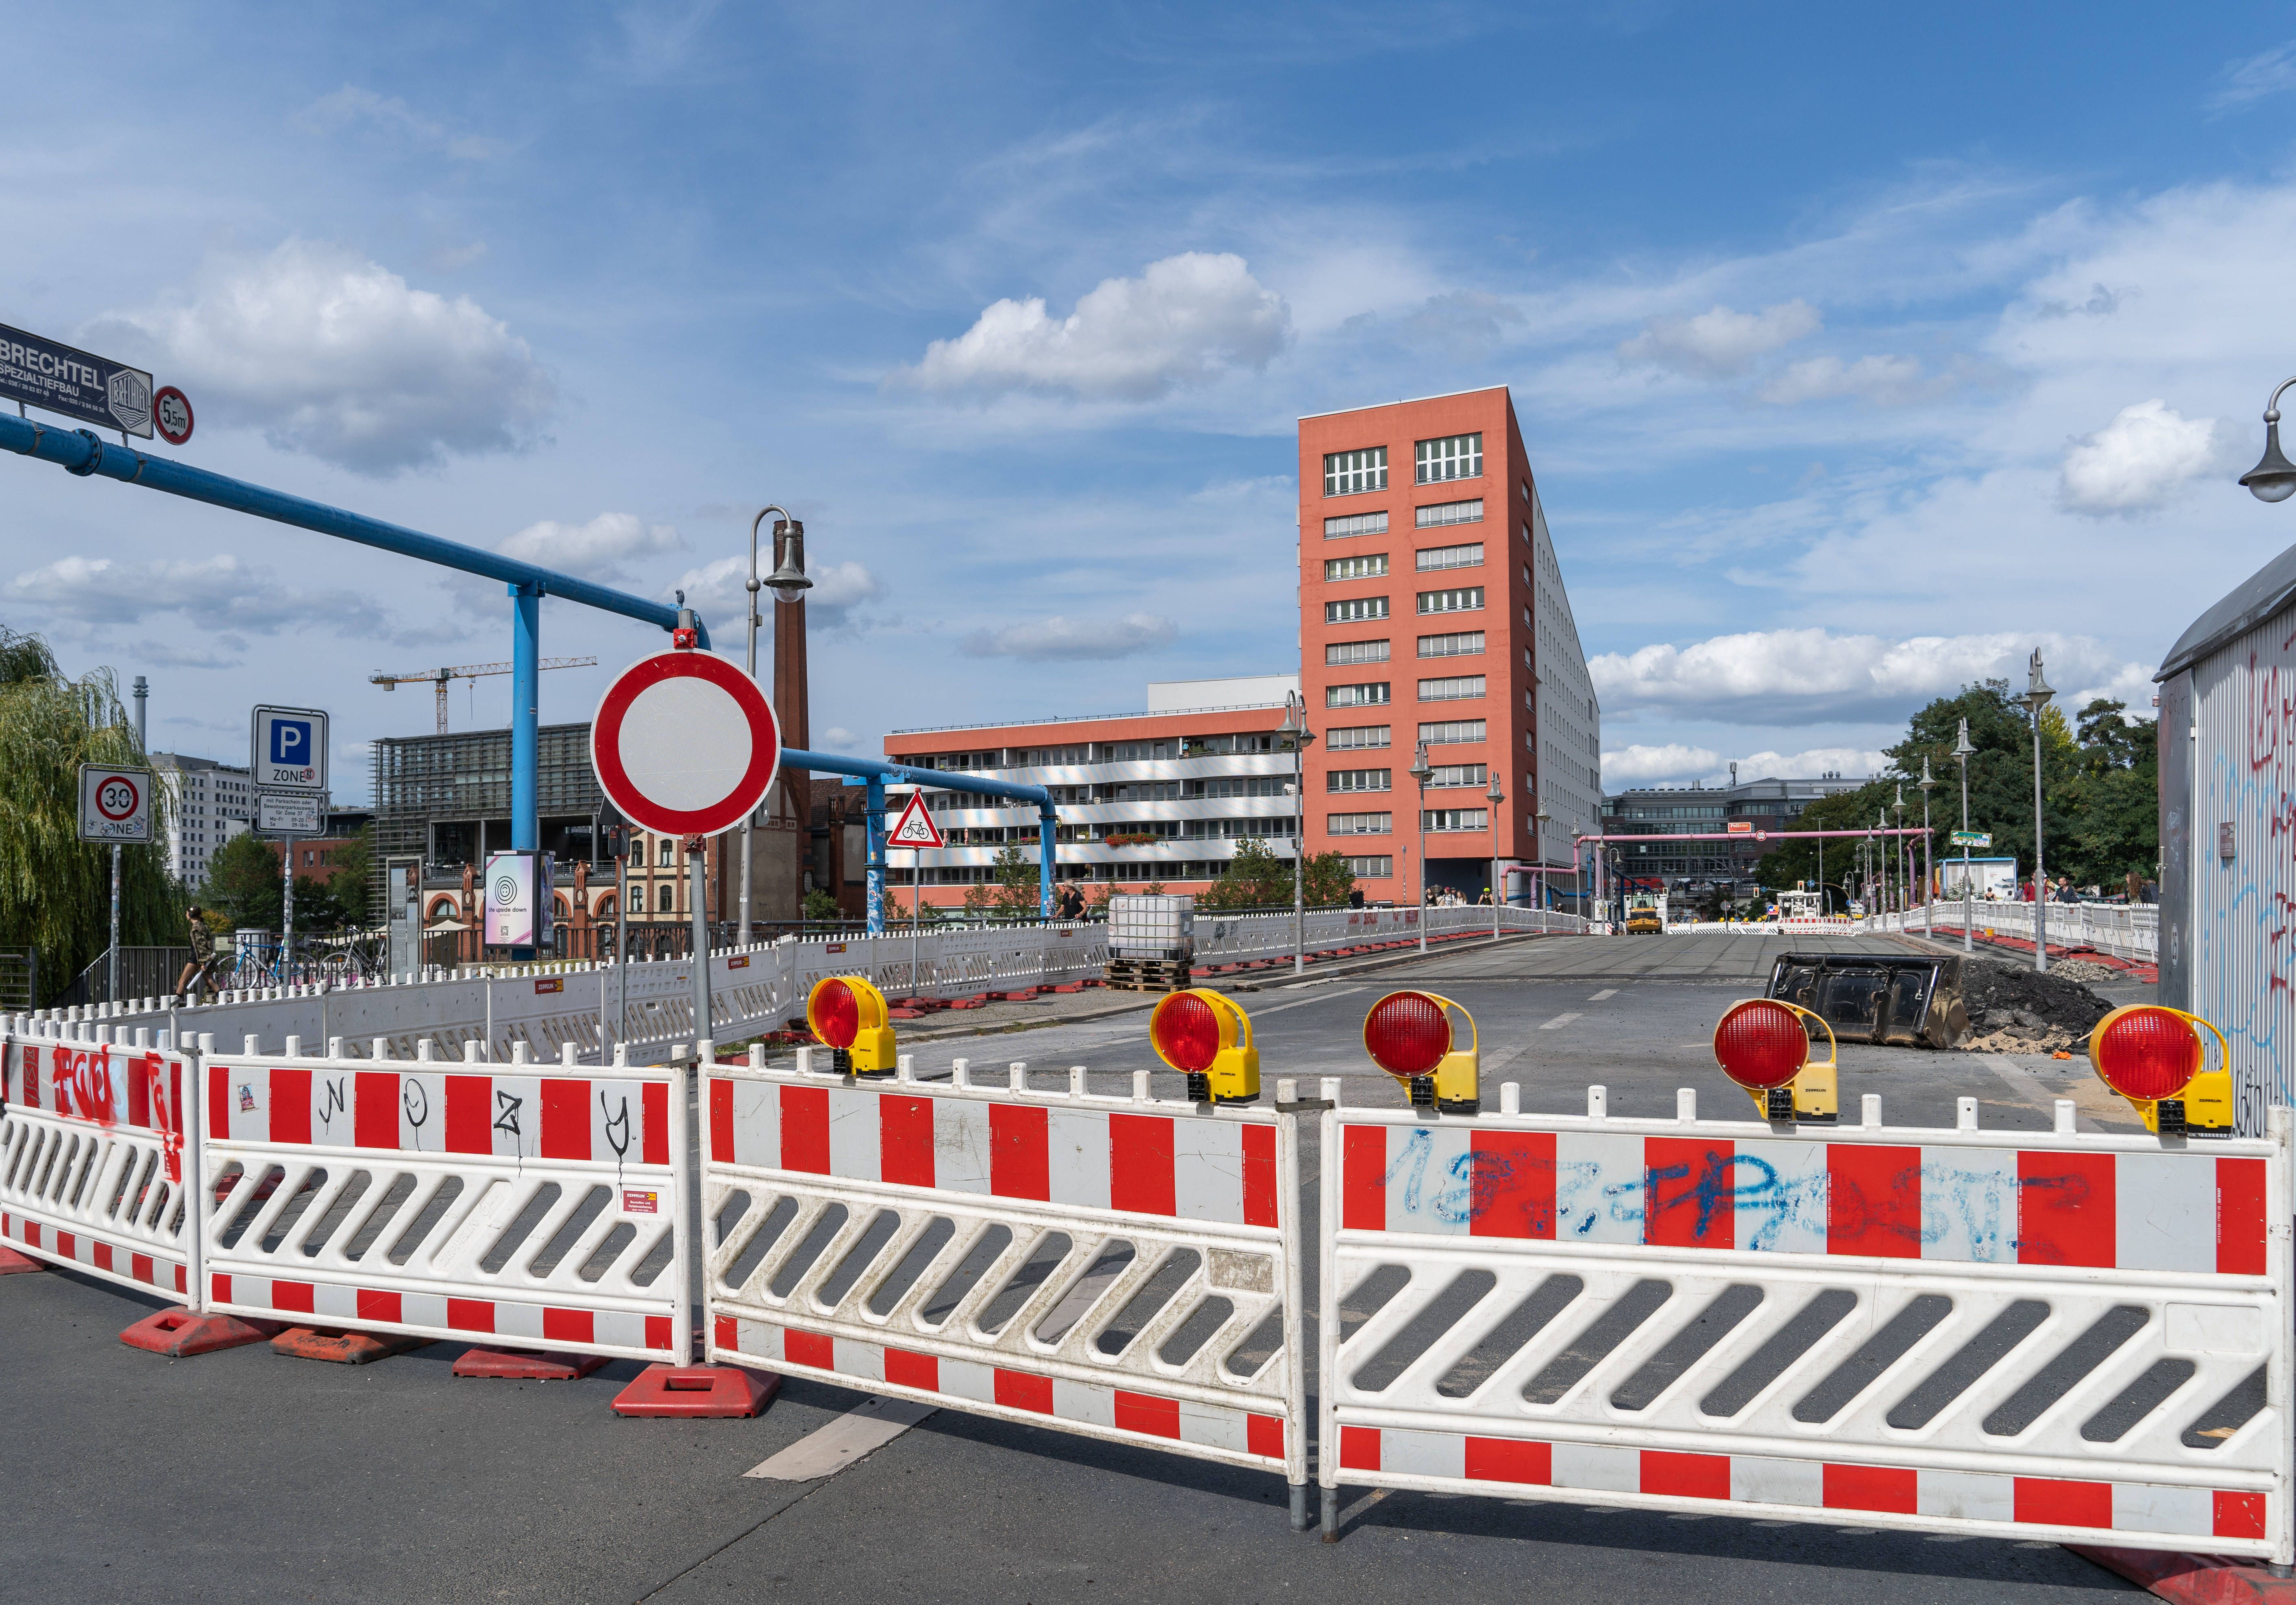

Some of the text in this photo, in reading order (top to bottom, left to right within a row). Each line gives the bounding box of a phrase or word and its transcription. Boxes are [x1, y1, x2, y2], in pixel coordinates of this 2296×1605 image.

[0, 339, 104, 391] BRECHTEL
[0, 363, 79, 396] SPEZIALTIEFBAU
[114, 375, 146, 413] BRECHTEL
[163, 400, 186, 429] 5,5m
[281, 726, 301, 758] P
[273, 769, 307, 783] ZONE
[105, 787, 130, 808] 30
